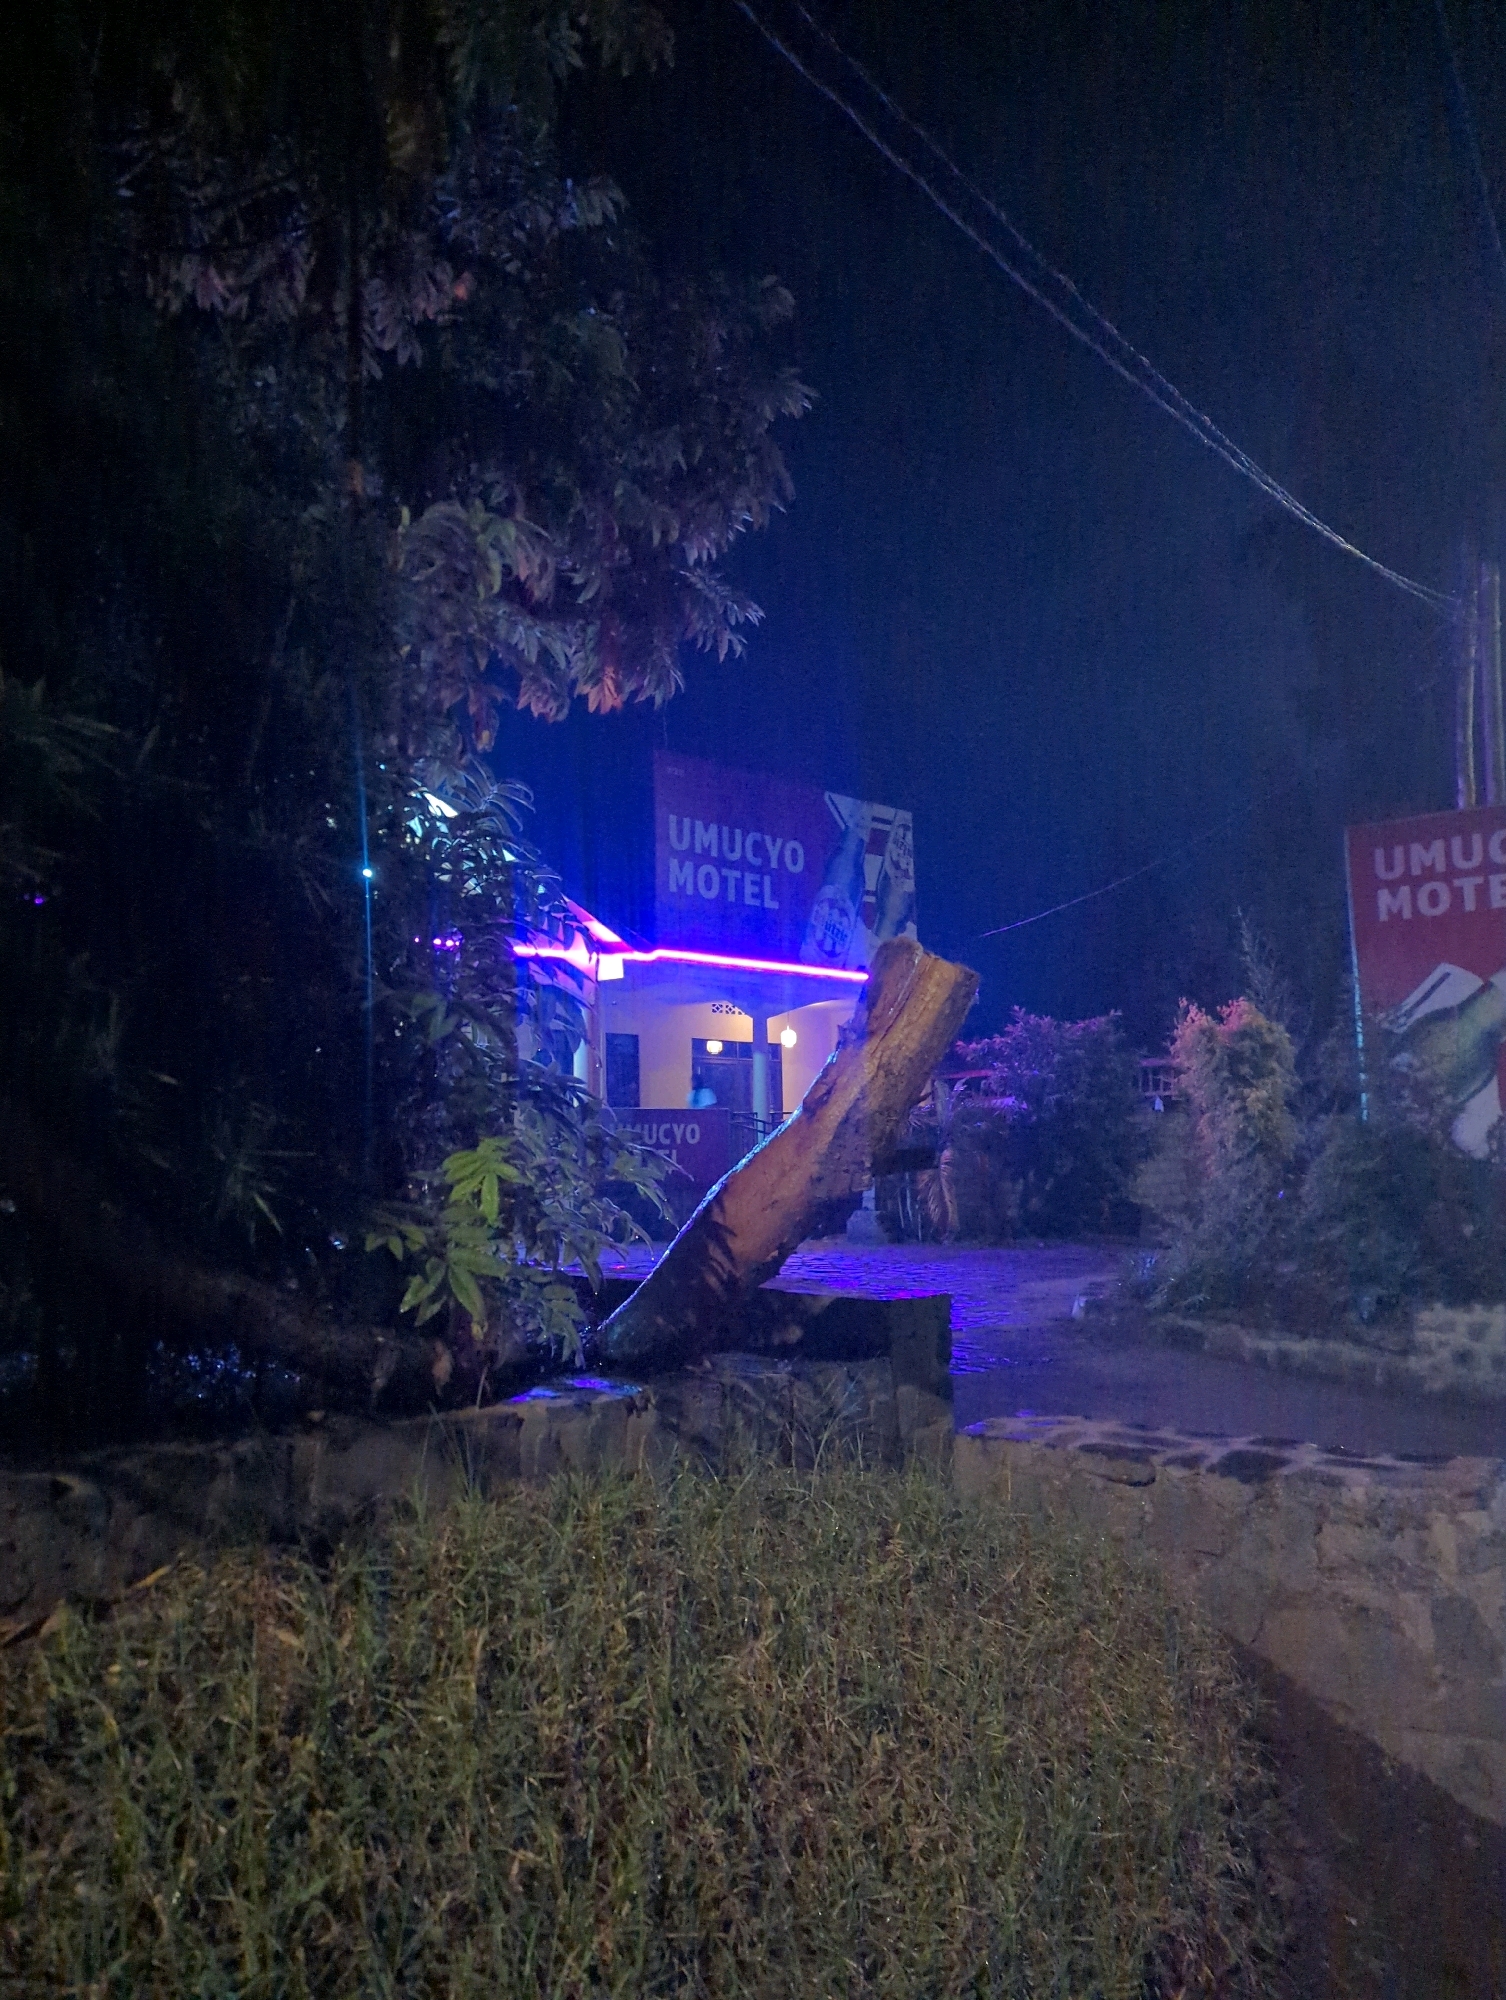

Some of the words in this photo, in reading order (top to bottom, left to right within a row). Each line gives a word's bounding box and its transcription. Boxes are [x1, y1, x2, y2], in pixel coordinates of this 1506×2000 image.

[668, 813, 805, 873] UMUCYO
[668, 857, 780, 910] MOTEL
[1377, 873, 1506, 922] MOTE
[608, 1123, 701, 1145] UCYO
